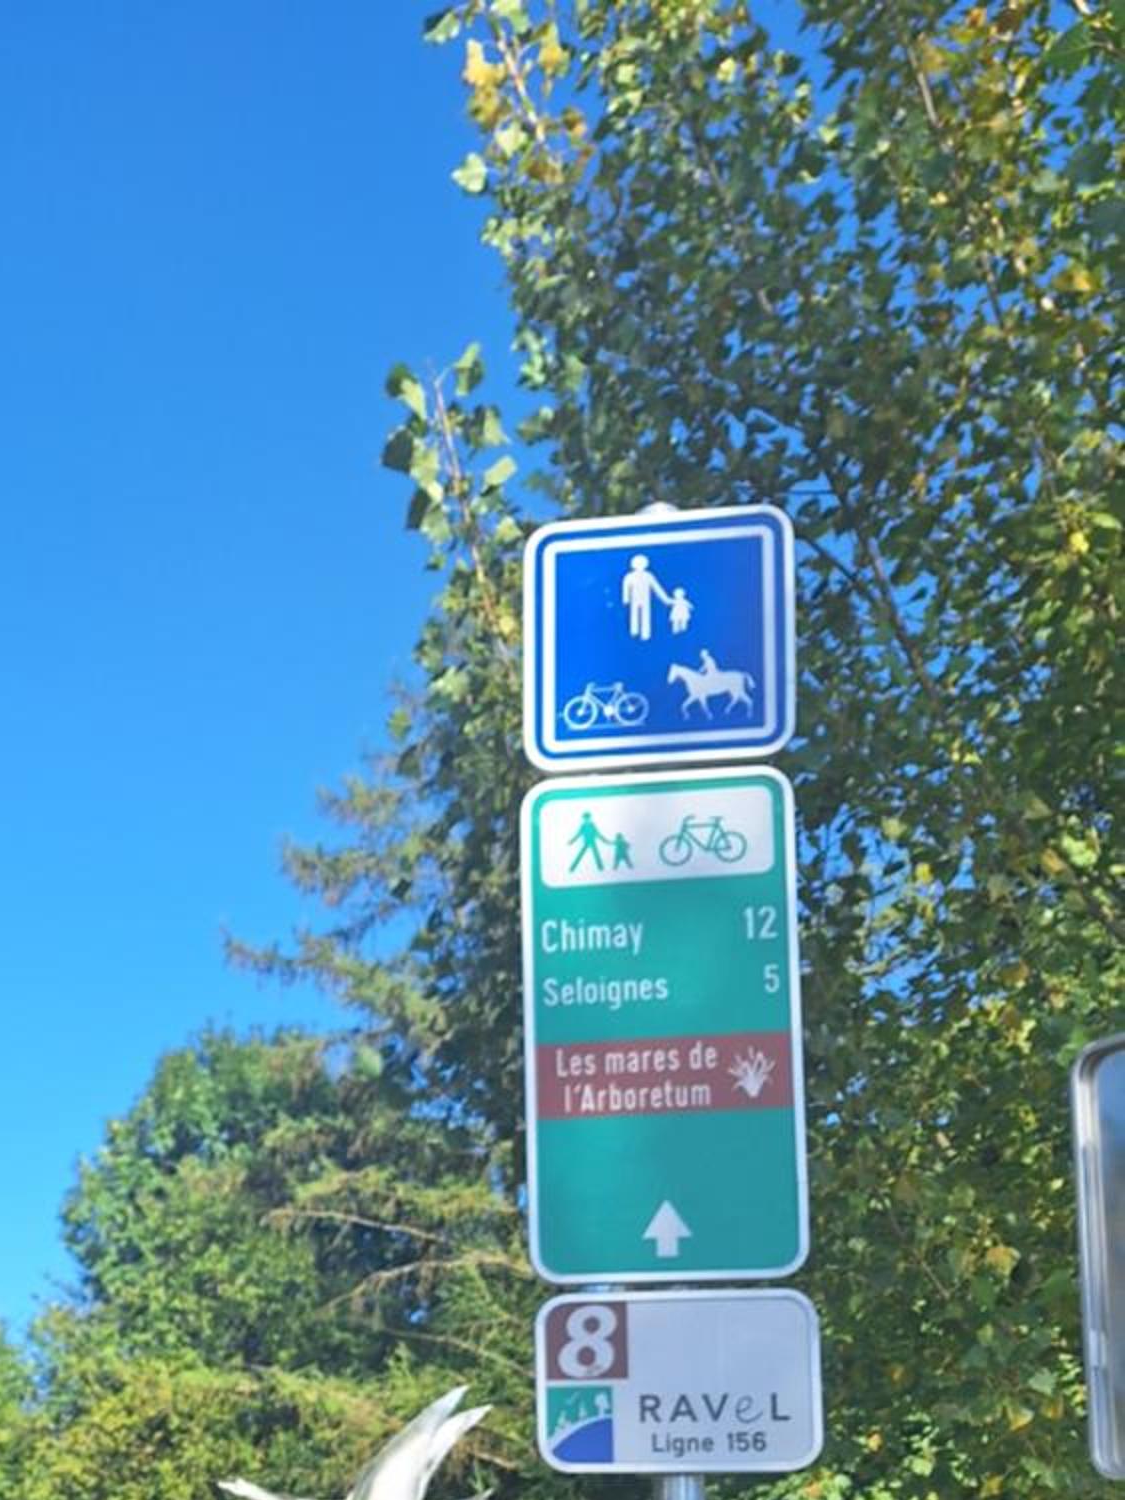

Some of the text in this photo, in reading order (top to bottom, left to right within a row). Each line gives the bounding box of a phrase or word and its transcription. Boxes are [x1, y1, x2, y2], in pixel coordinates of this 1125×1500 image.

[541, 905, 778, 955] Chimay 12
[543, 963, 780, 1011] Seloignes 5
[556, 1041, 717, 1077] Les mares de
[564, 1080, 711, 1113] l'Arboretum
[557, 1304, 617, 1378] 8
[639, 1391, 791, 1424] RAVeL
[651, 1431, 767, 1458] Ligne 156
